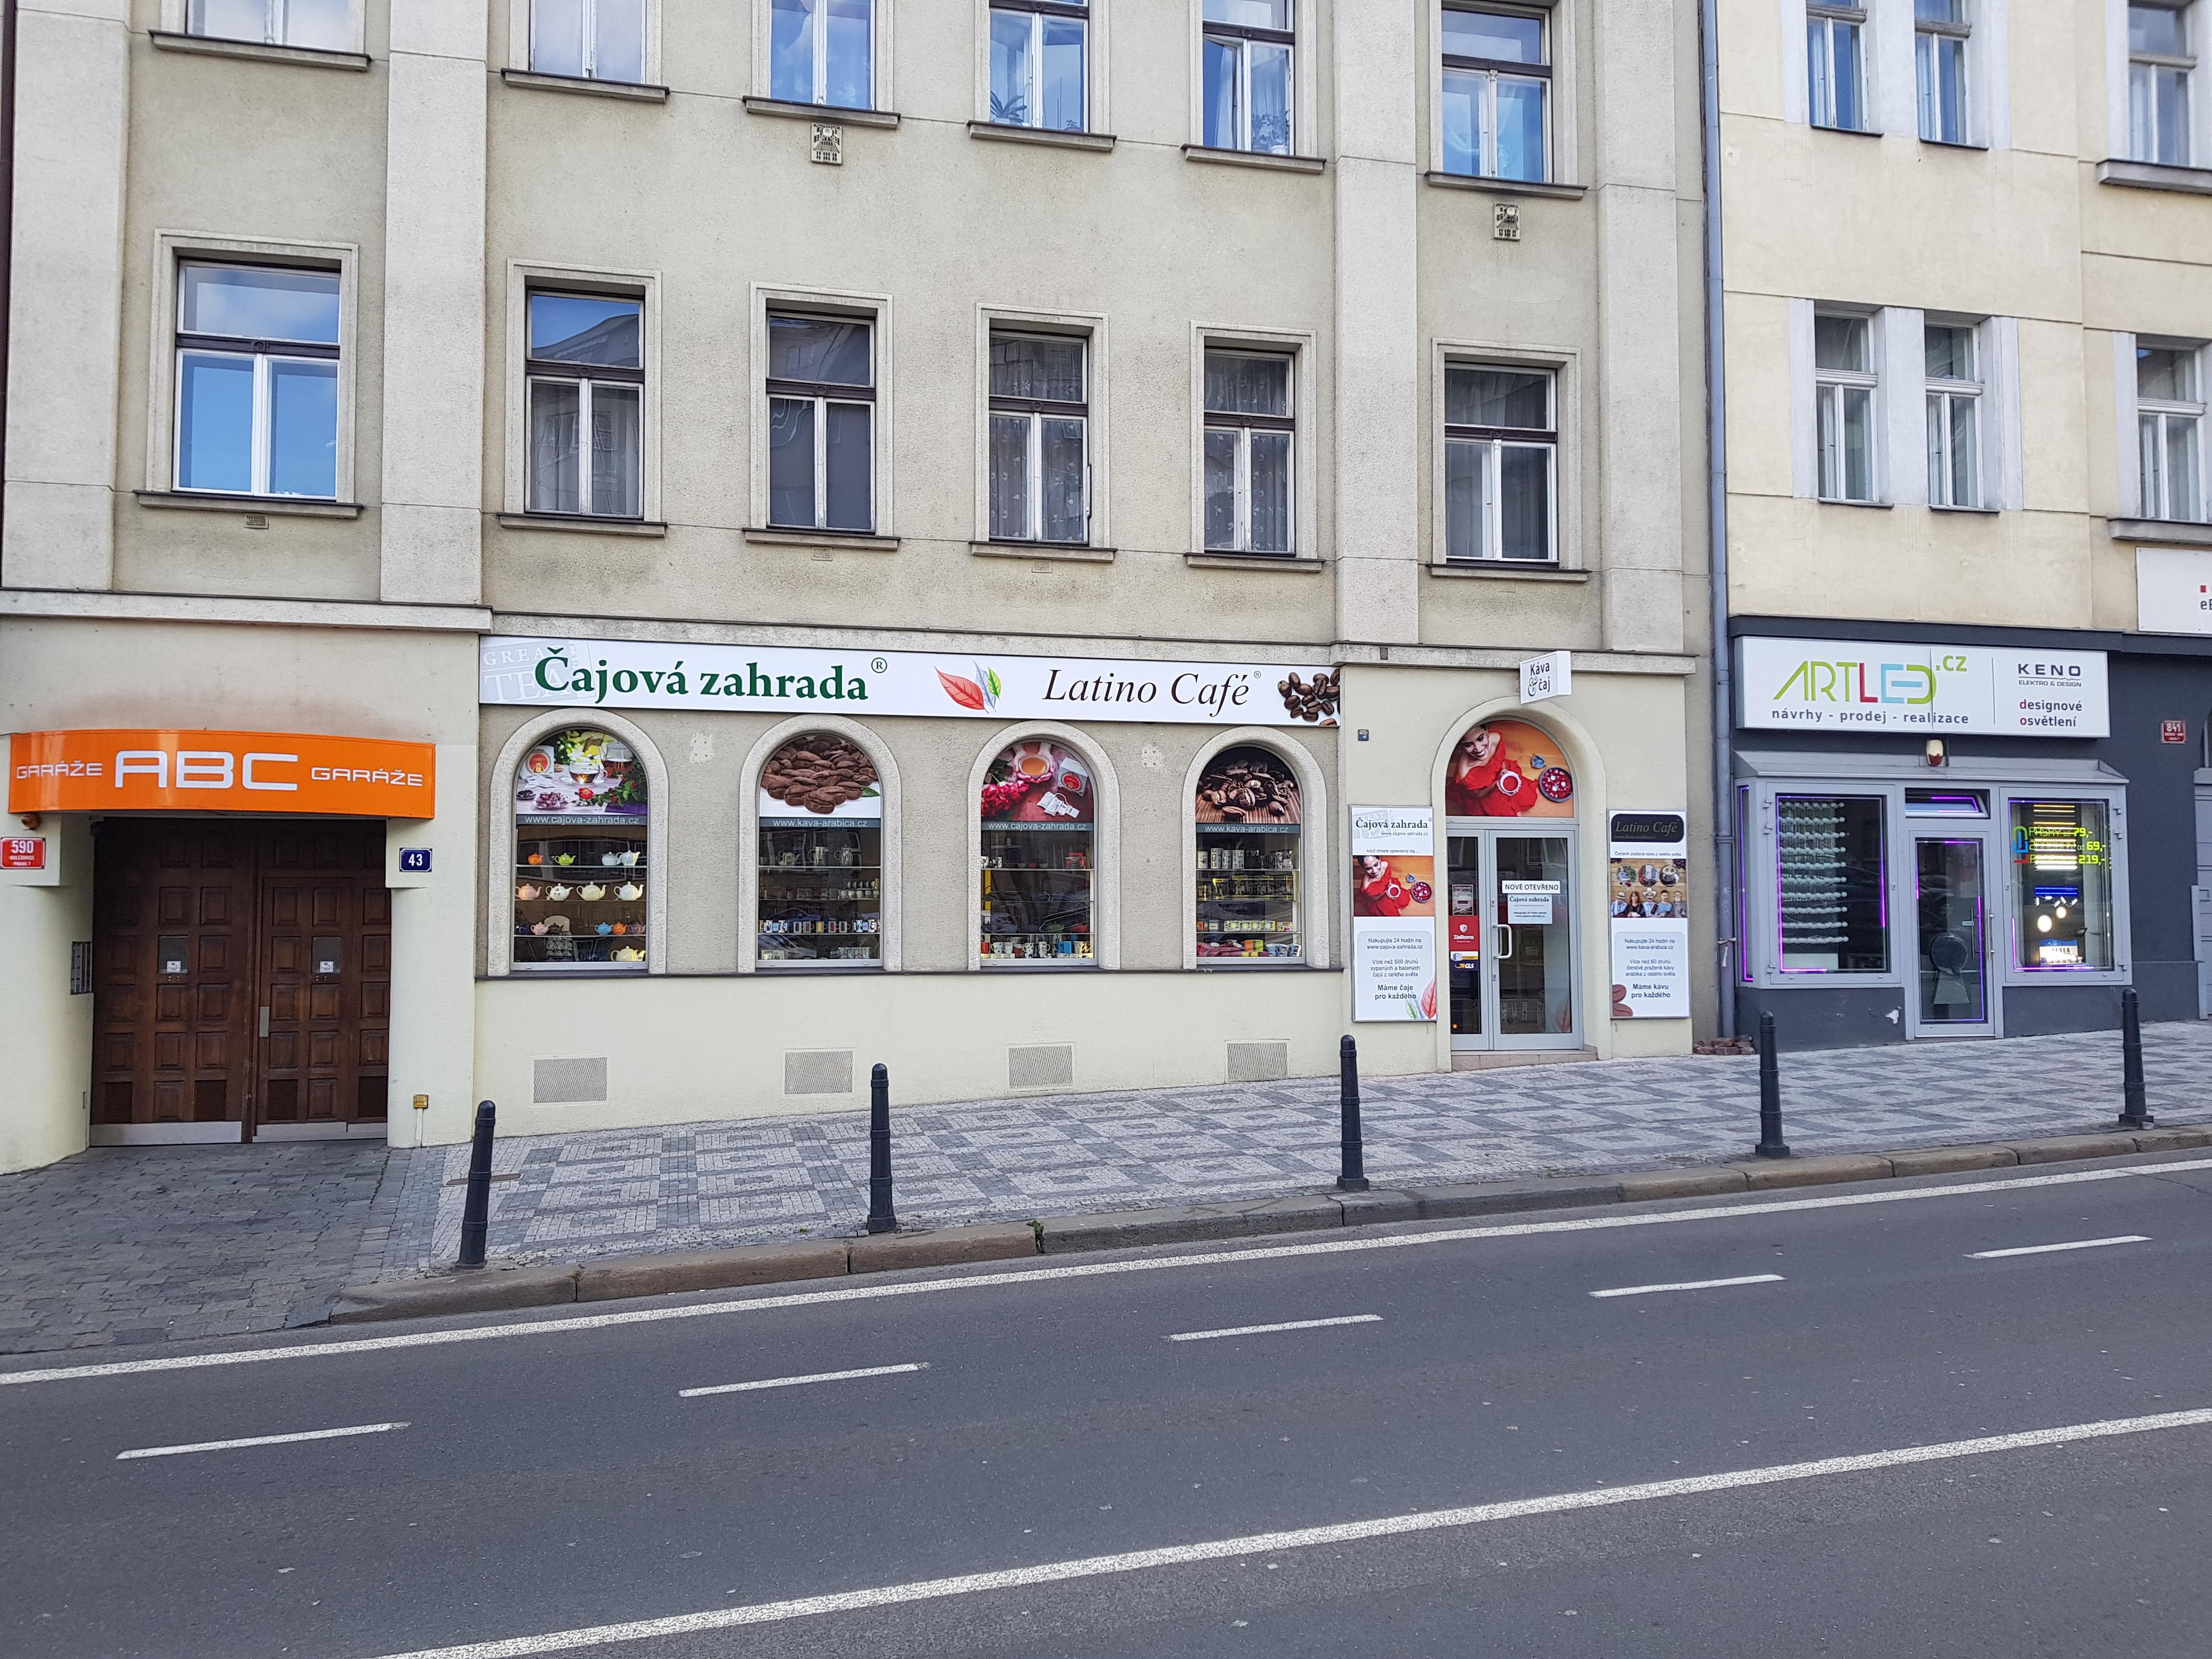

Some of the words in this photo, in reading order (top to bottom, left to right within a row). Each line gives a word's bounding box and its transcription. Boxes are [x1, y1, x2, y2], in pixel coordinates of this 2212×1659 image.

[535, 646, 688, 704] Čajová
[700, 662, 868, 700] zahrada
[1530, 661, 1550, 676] Káva
[2018, 663, 2081, 676] KENO
[1538, 676, 1550, 692] čaj
[1773, 660, 1937, 705] ARTLED
[1041, 669, 1156, 703] Latino
[1171, 673, 1249, 717] Café
[2020, 699, 2083, 713] designové
[1772, 707, 1823, 722] návrhy
[1840, 711, 1886, 724] prodej
[1903, 712, 1969, 724] realizace
[2020, 715, 2077, 727] osvětlení
[2166, 722, 2181, 732] 841
[17, 759, 103, 779] GARÁŽE
[114, 750, 299, 791] ABC
[311, 768, 423, 787] GARÁŽE
[525, 815, 639, 825] www.cajova-zahrada.cz
[773, 818, 868, 827] www.kava-arabica.cz
[988, 822, 1087, 831] www.cajova-zahrada.cz
[1355, 817, 1389, 831] Čajová
[1391, 820, 1428, 828] zahrada
[1204, 825, 1289, 833] www.kava-arabica.cz
[1615, 821, 1650, 832] Latino
[1653, 821, 1678, 837] Café
[10, 840, 34, 854] 590
[2086, 841, 2106, 852] 69,-
[408, 853, 423, 867] 43
[2078, 854, 2105, 865] 219,-
[1509, 895, 1527, 904] Čajová
